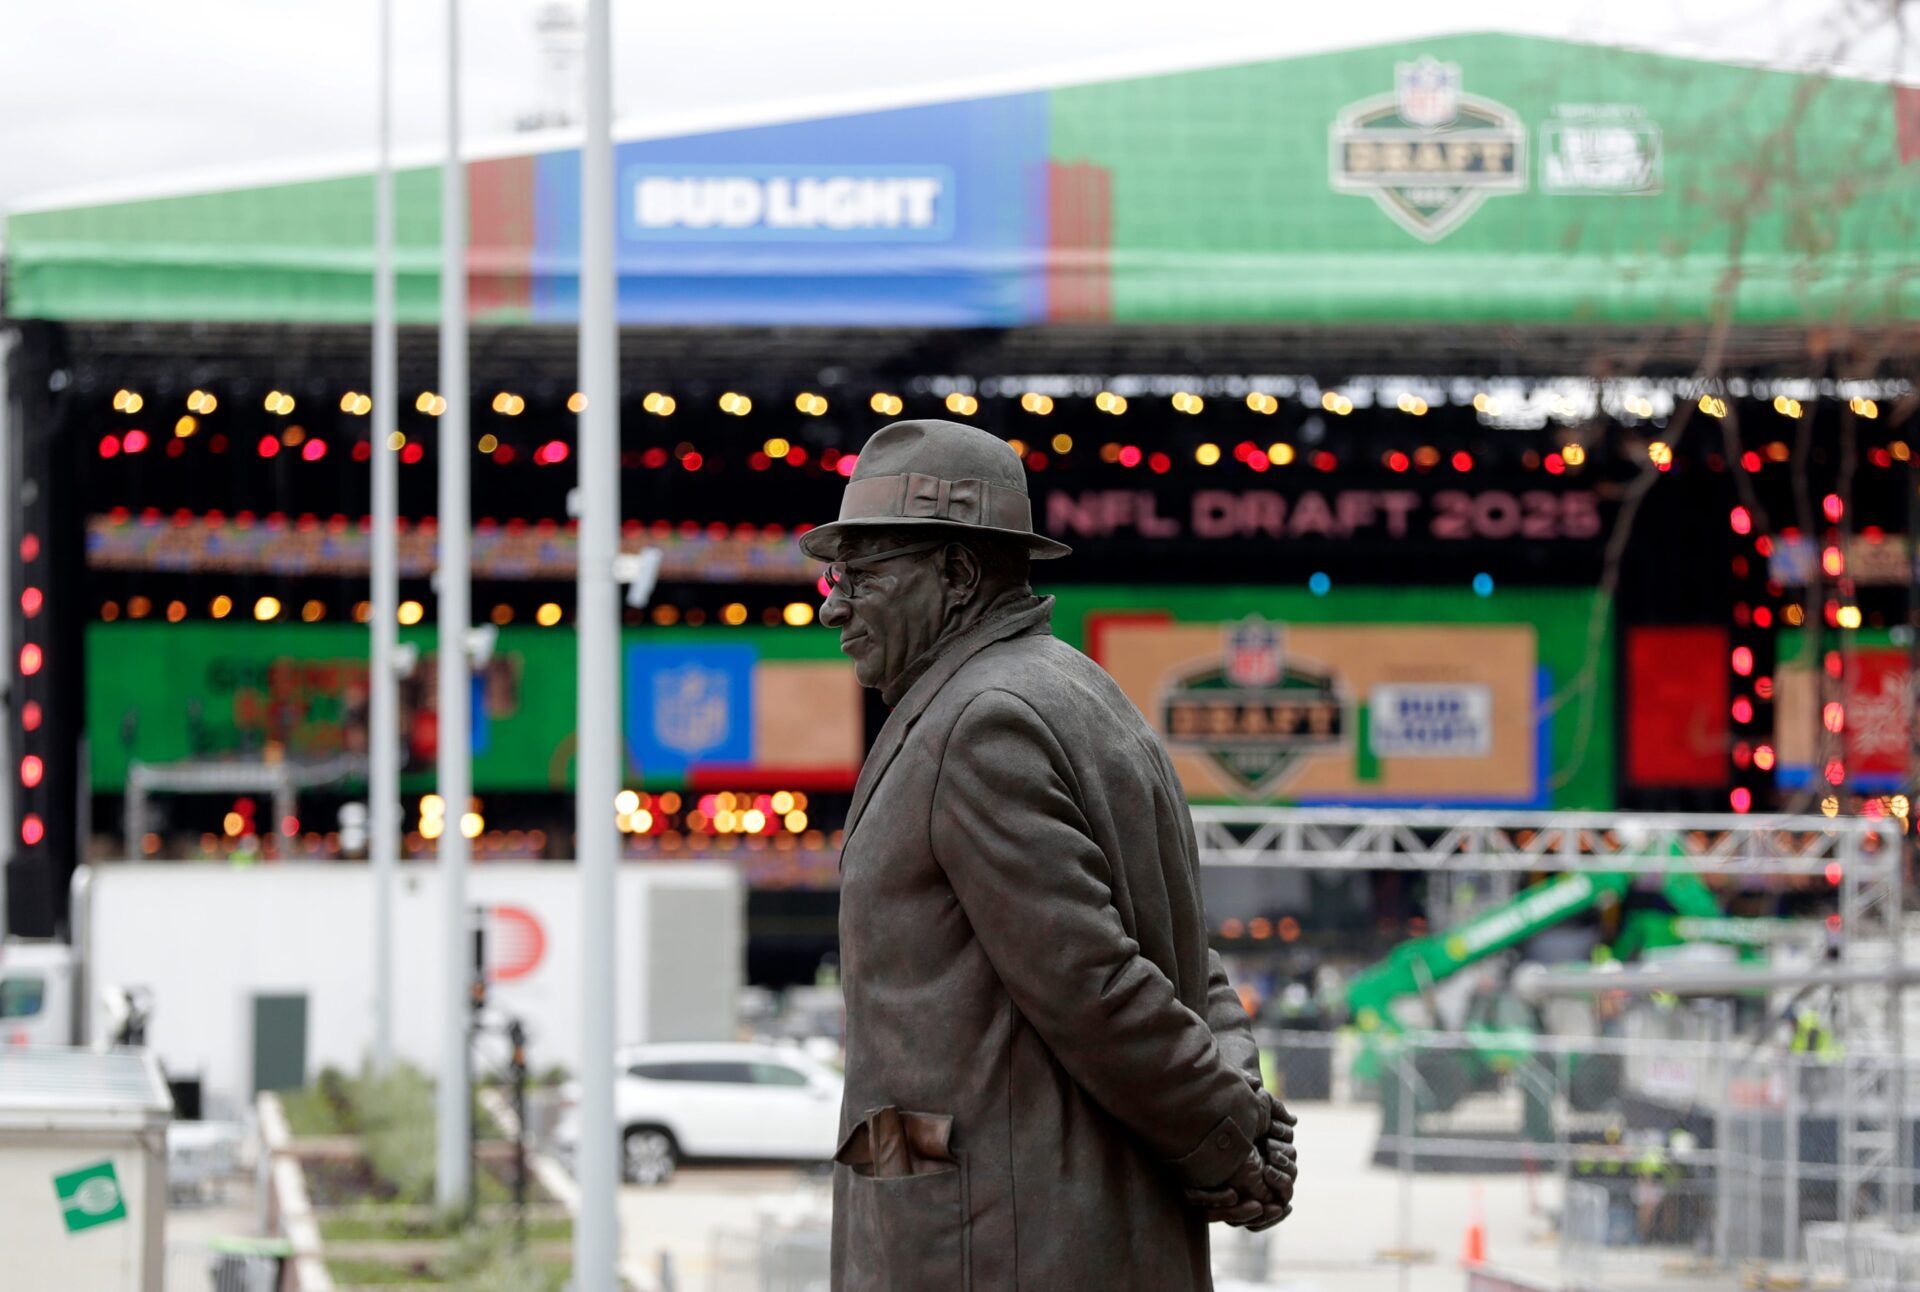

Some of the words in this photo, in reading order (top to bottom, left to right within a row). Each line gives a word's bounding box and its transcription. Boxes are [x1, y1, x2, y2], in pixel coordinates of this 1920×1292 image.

[636, 177, 762, 228] BUD
[768, 177, 941, 229] LIGHT
[1048, 491, 1179, 538] NFL
[1192, 491, 1417, 538] DRAFT
[1431, 491, 1600, 538] 2025
